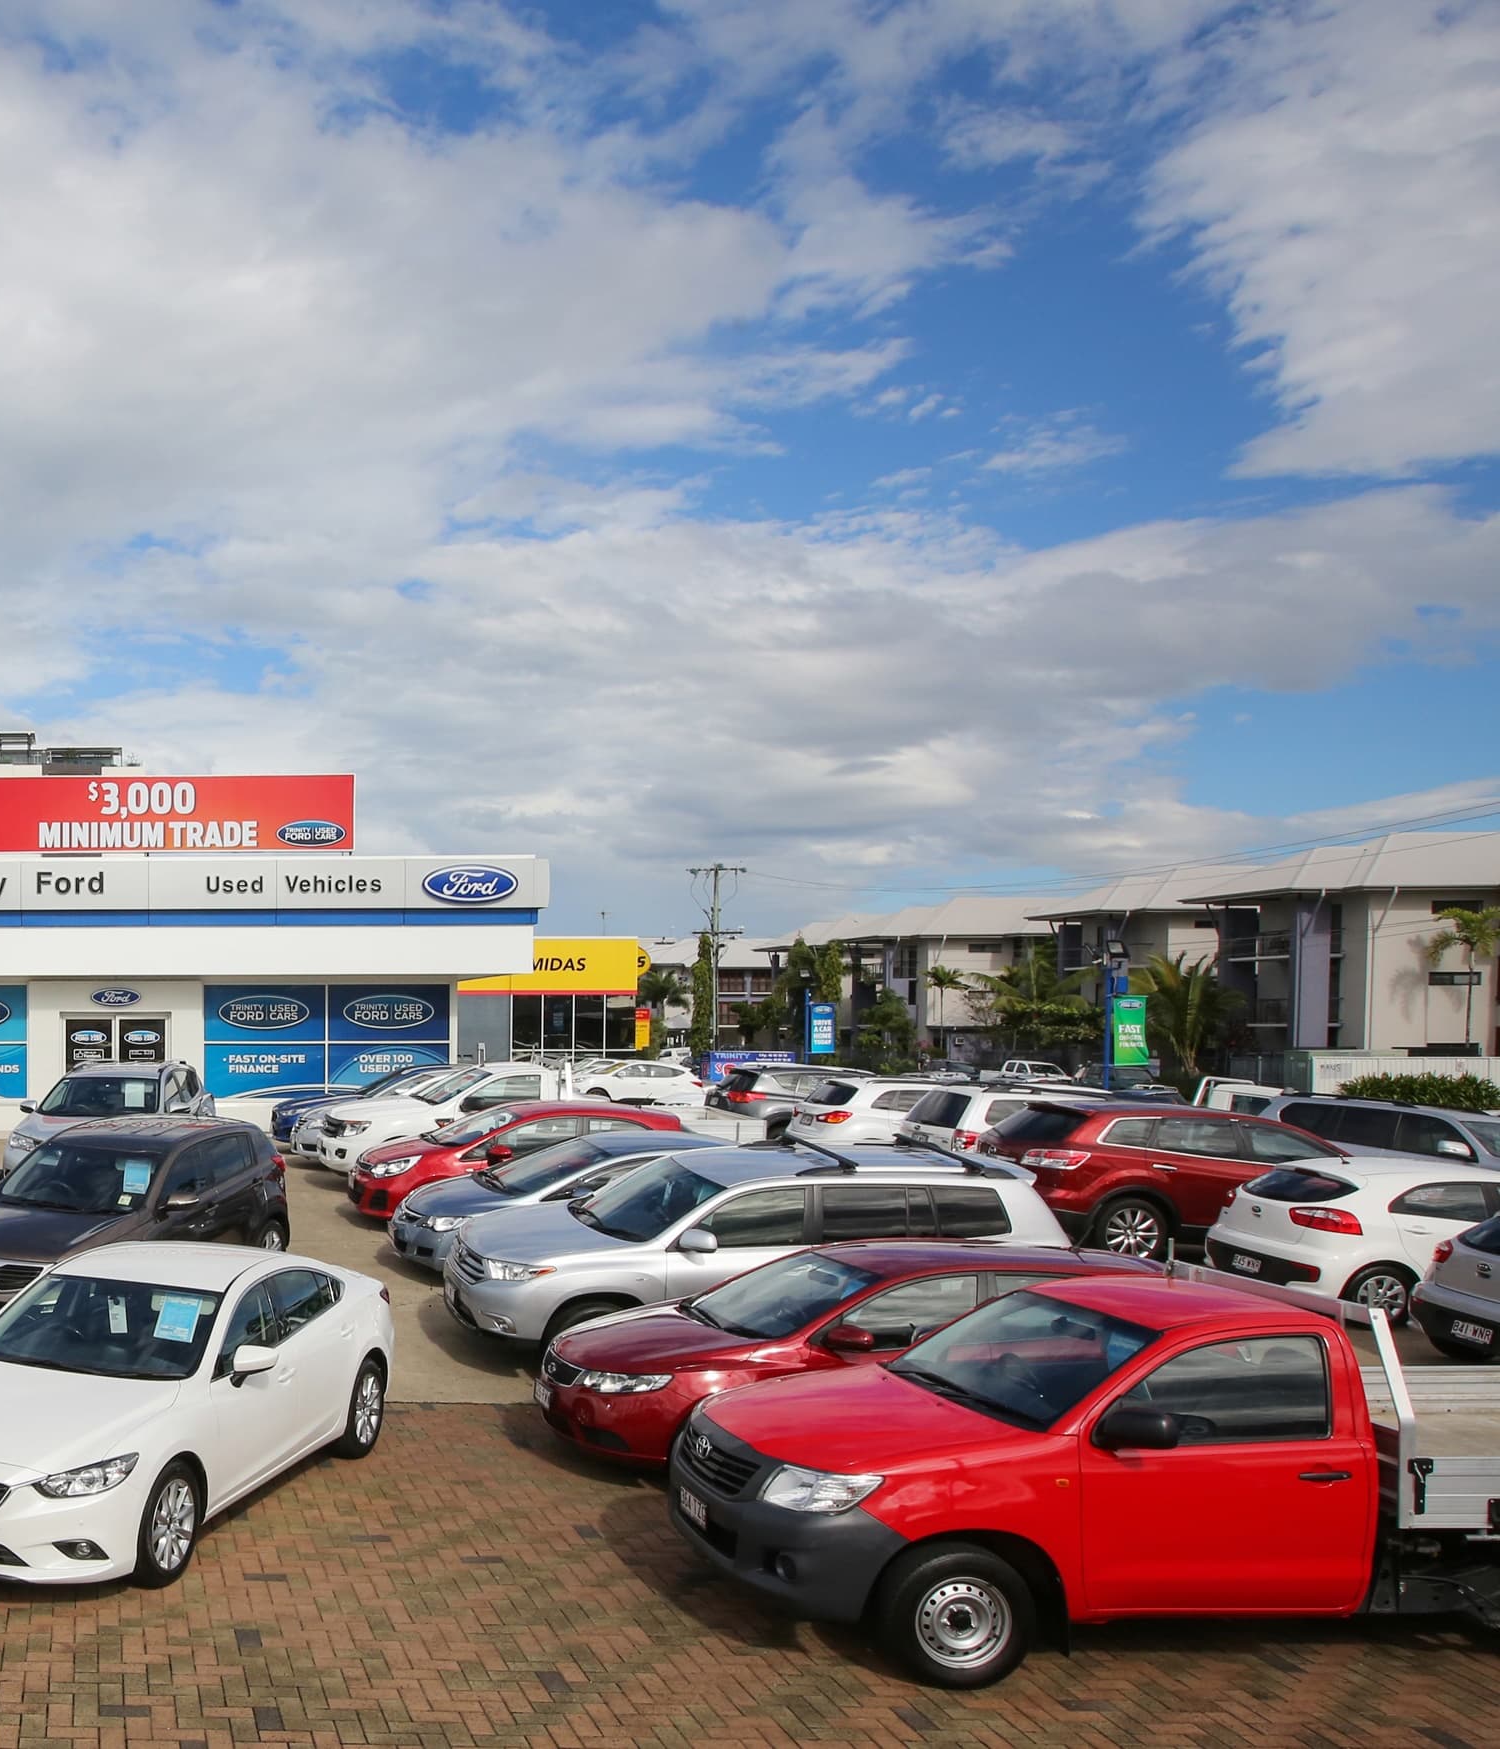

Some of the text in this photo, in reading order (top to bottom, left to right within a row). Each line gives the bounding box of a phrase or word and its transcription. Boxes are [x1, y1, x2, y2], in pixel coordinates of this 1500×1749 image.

[88, 781, 196, 819] $3,000
[38, 821, 258, 849] MINIMUM TRADE
[36, 872, 105, 895] Ford
[206, 875, 382, 893] Used Vehicles
[441, 871, 500, 896] Ford
[533, 957, 587, 972] MIDAS
[101, 991, 131, 1002] Ford
[269, 1004, 298, 1012] USED
[394, 1004, 423, 1012] USED
[230, 1011, 264, 1020] FORD
[269, 1012, 298, 1020] CARS
[354, 1011, 389, 1020] FORD
[394, 1012, 423, 1020] CARS
[1119, 1025, 1141, 1033] FAST
[228, 1055, 306, 1063] FAST ON-SITE
[360, 1054, 413, 1063] OVER 100
[228, 1065, 279, 1073] FINANCE
[360, 1064, 391, 1073] USED
